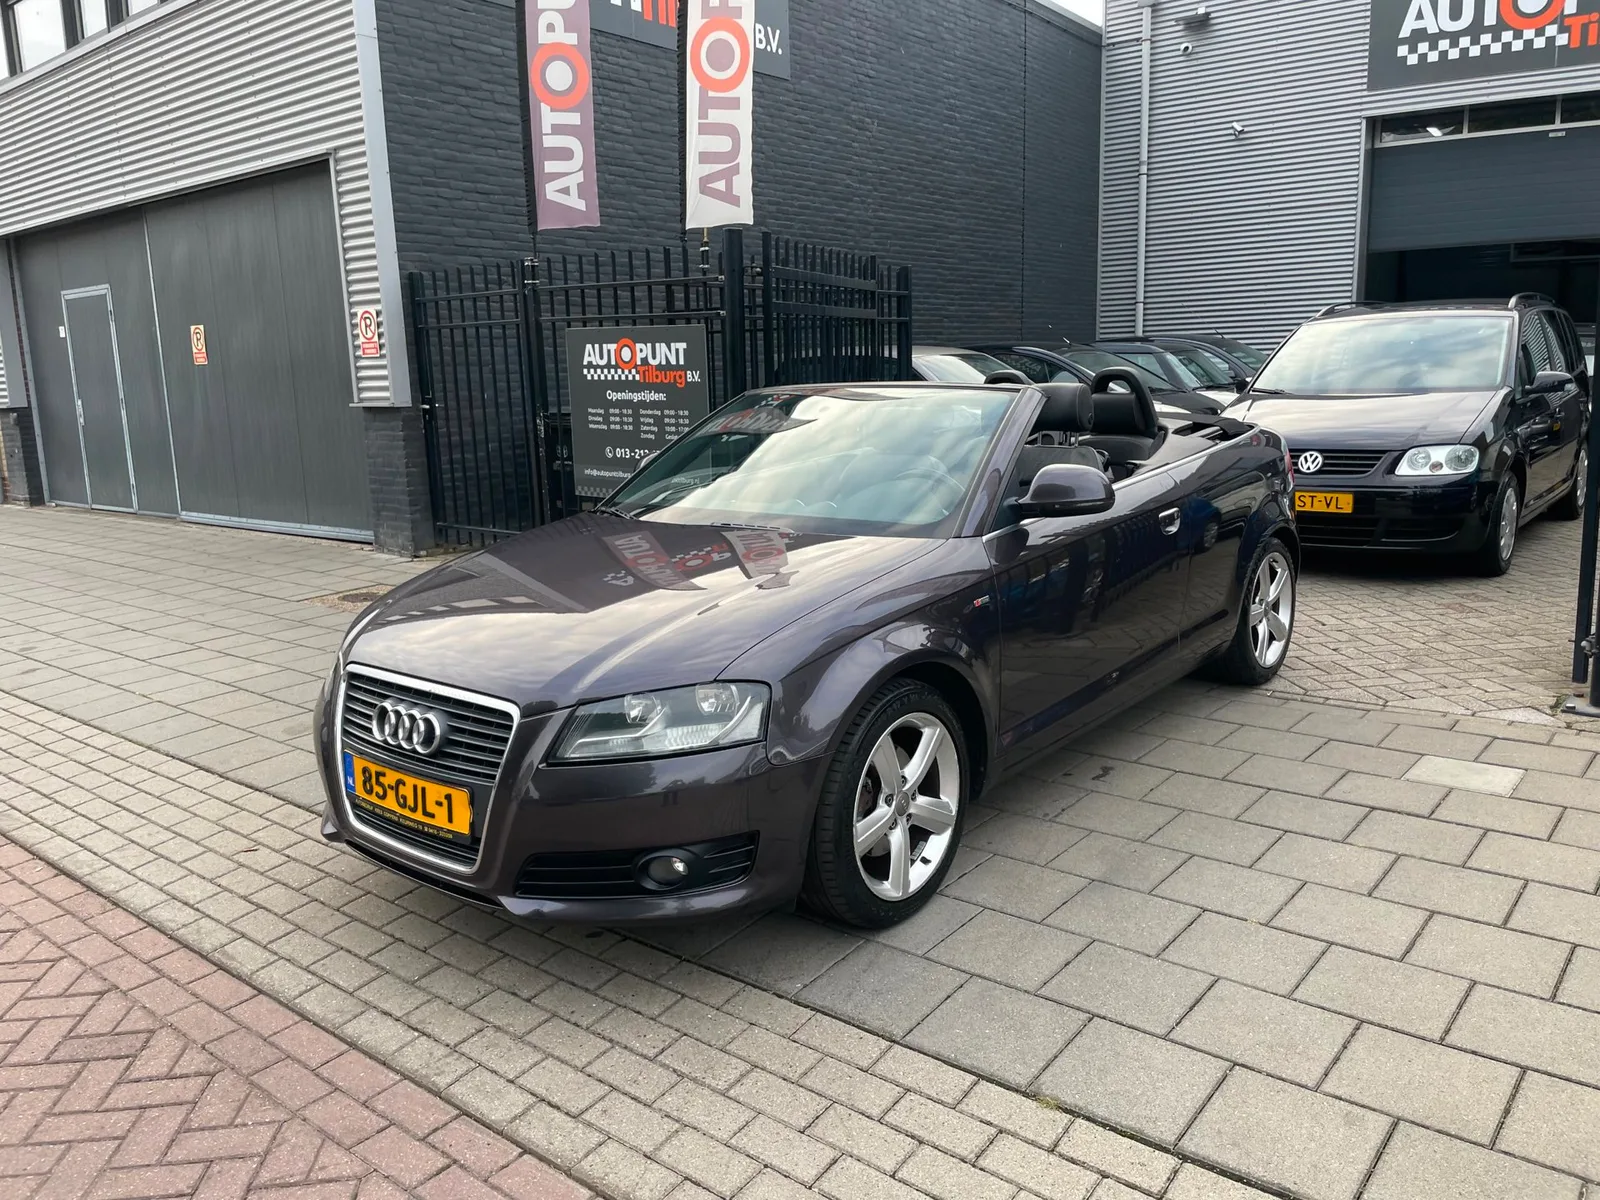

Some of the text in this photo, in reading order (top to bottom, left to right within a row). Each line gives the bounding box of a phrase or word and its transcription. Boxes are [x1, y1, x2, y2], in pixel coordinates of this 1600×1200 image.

[755, 24, 782, 54] B.V.
[531, 0, 590, 211] AUTOP
[583, 338, 687, 370] AUTOPUNT
[637, 365, 701, 388] Tilburg B.V.
[606, 390, 667, 403] Openingstijden:
[1297, 494, 1344, 510] ST-VL
[361, 766, 454, 824] 85-GJL-1
